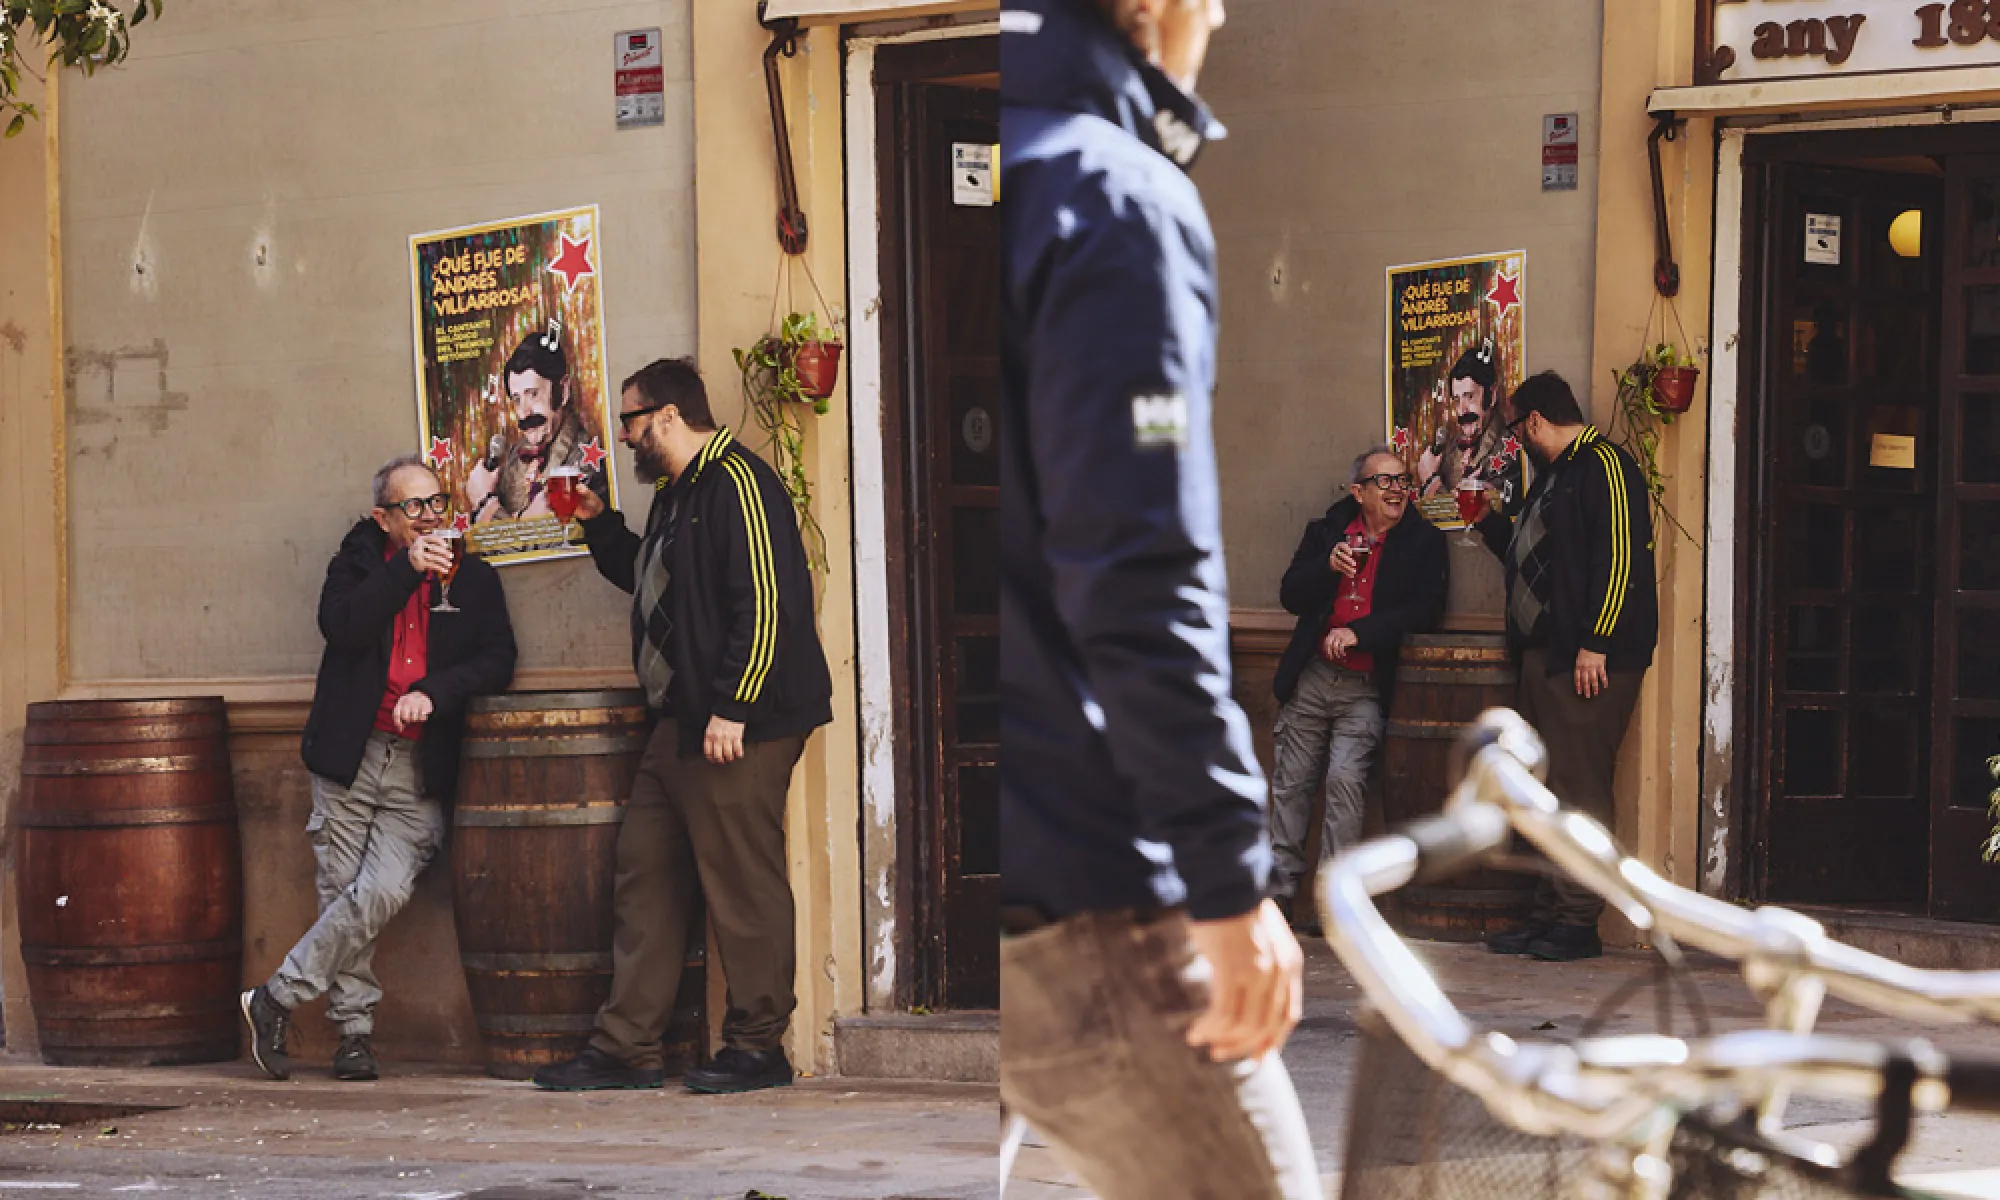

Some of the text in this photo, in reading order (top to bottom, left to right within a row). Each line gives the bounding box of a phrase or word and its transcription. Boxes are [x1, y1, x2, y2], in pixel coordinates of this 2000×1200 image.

[1752, 14, 1866, 65] any
[474, 249, 503, 271] FUE
[505, 244, 525, 265] DE
[1432, 280, 1453, 296] FUE
[1455, 278, 1471, 294] DE
